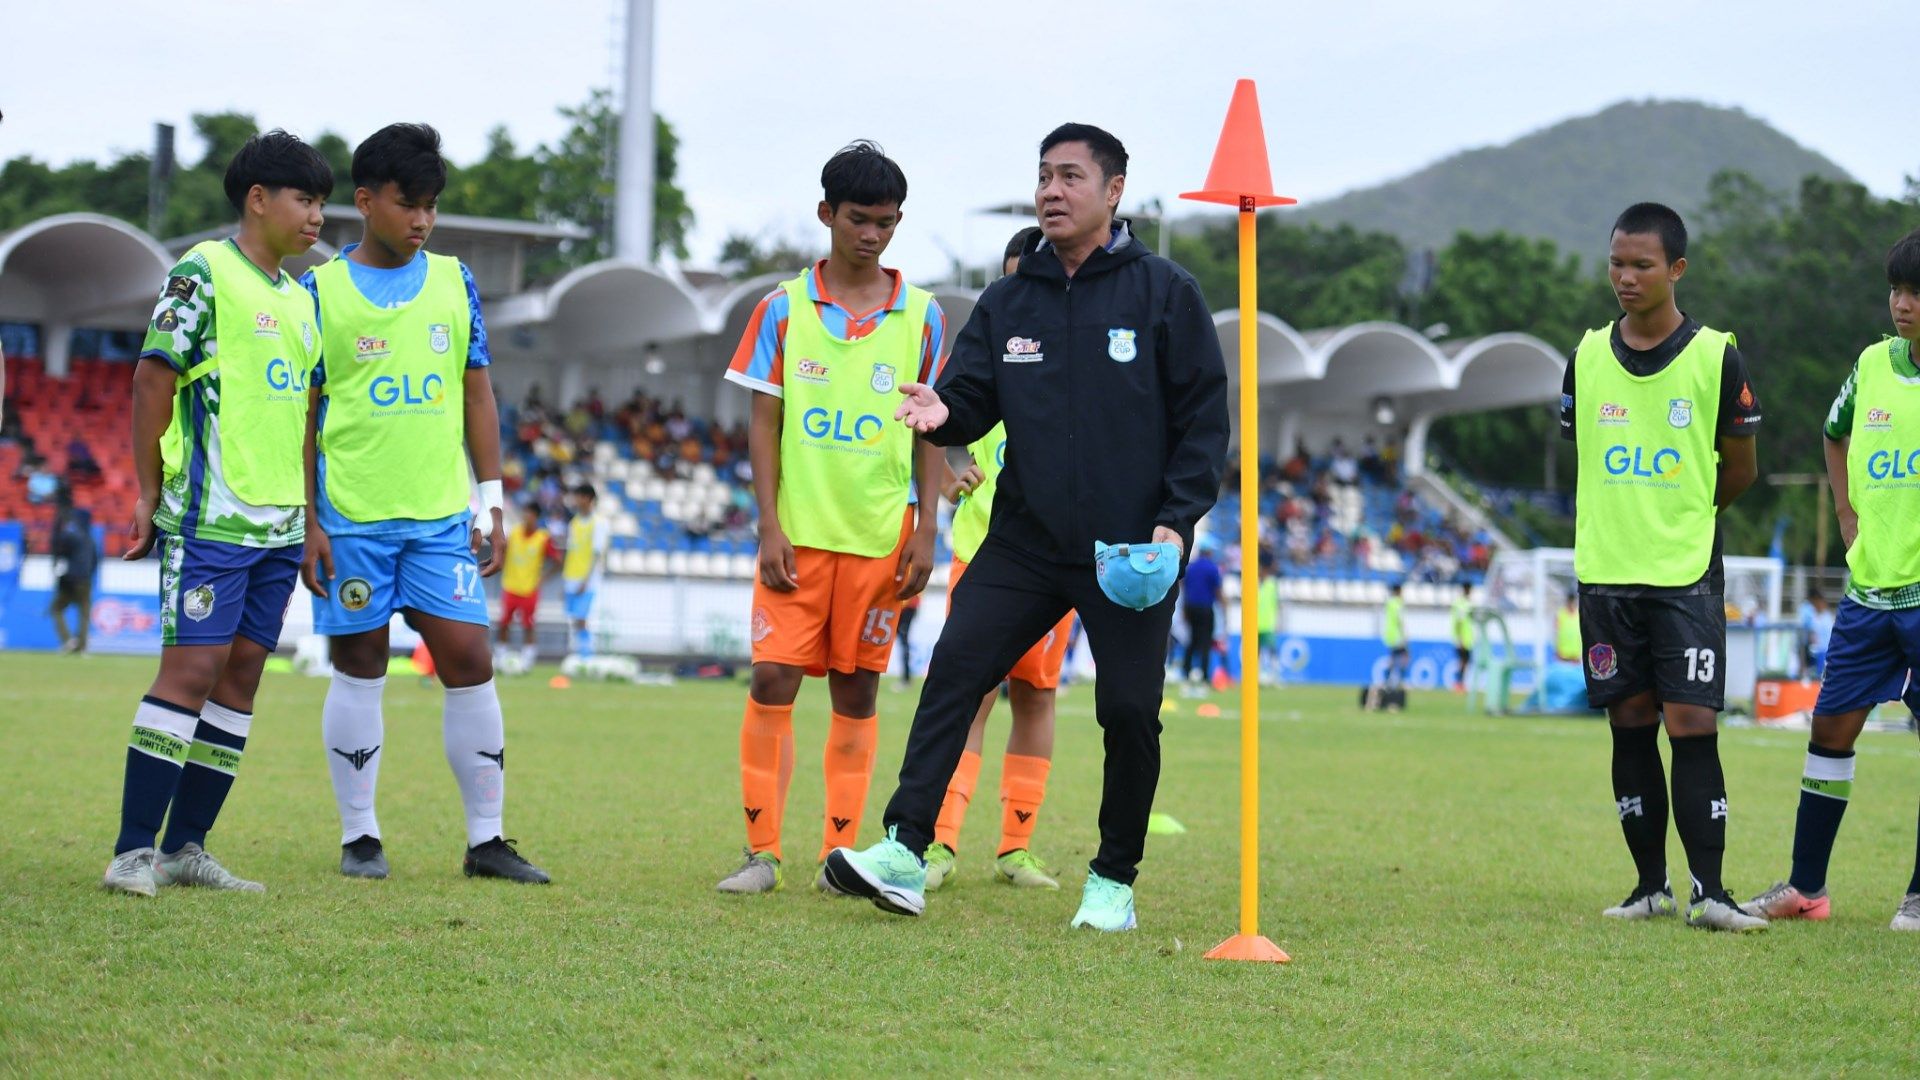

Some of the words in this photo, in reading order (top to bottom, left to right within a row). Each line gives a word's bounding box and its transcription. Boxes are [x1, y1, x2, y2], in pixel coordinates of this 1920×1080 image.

[369, 373, 444, 407] GLO
[802, 407, 884, 447] GLO
[1604, 445, 1684, 480] GLO
[452, 562, 478, 598] 17
[861, 608, 895, 645] 15
[1684, 647, 1716, 683] 13
[134, 727, 183, 753] SRIRACHA
[138, 737, 174, 758] UNITED
